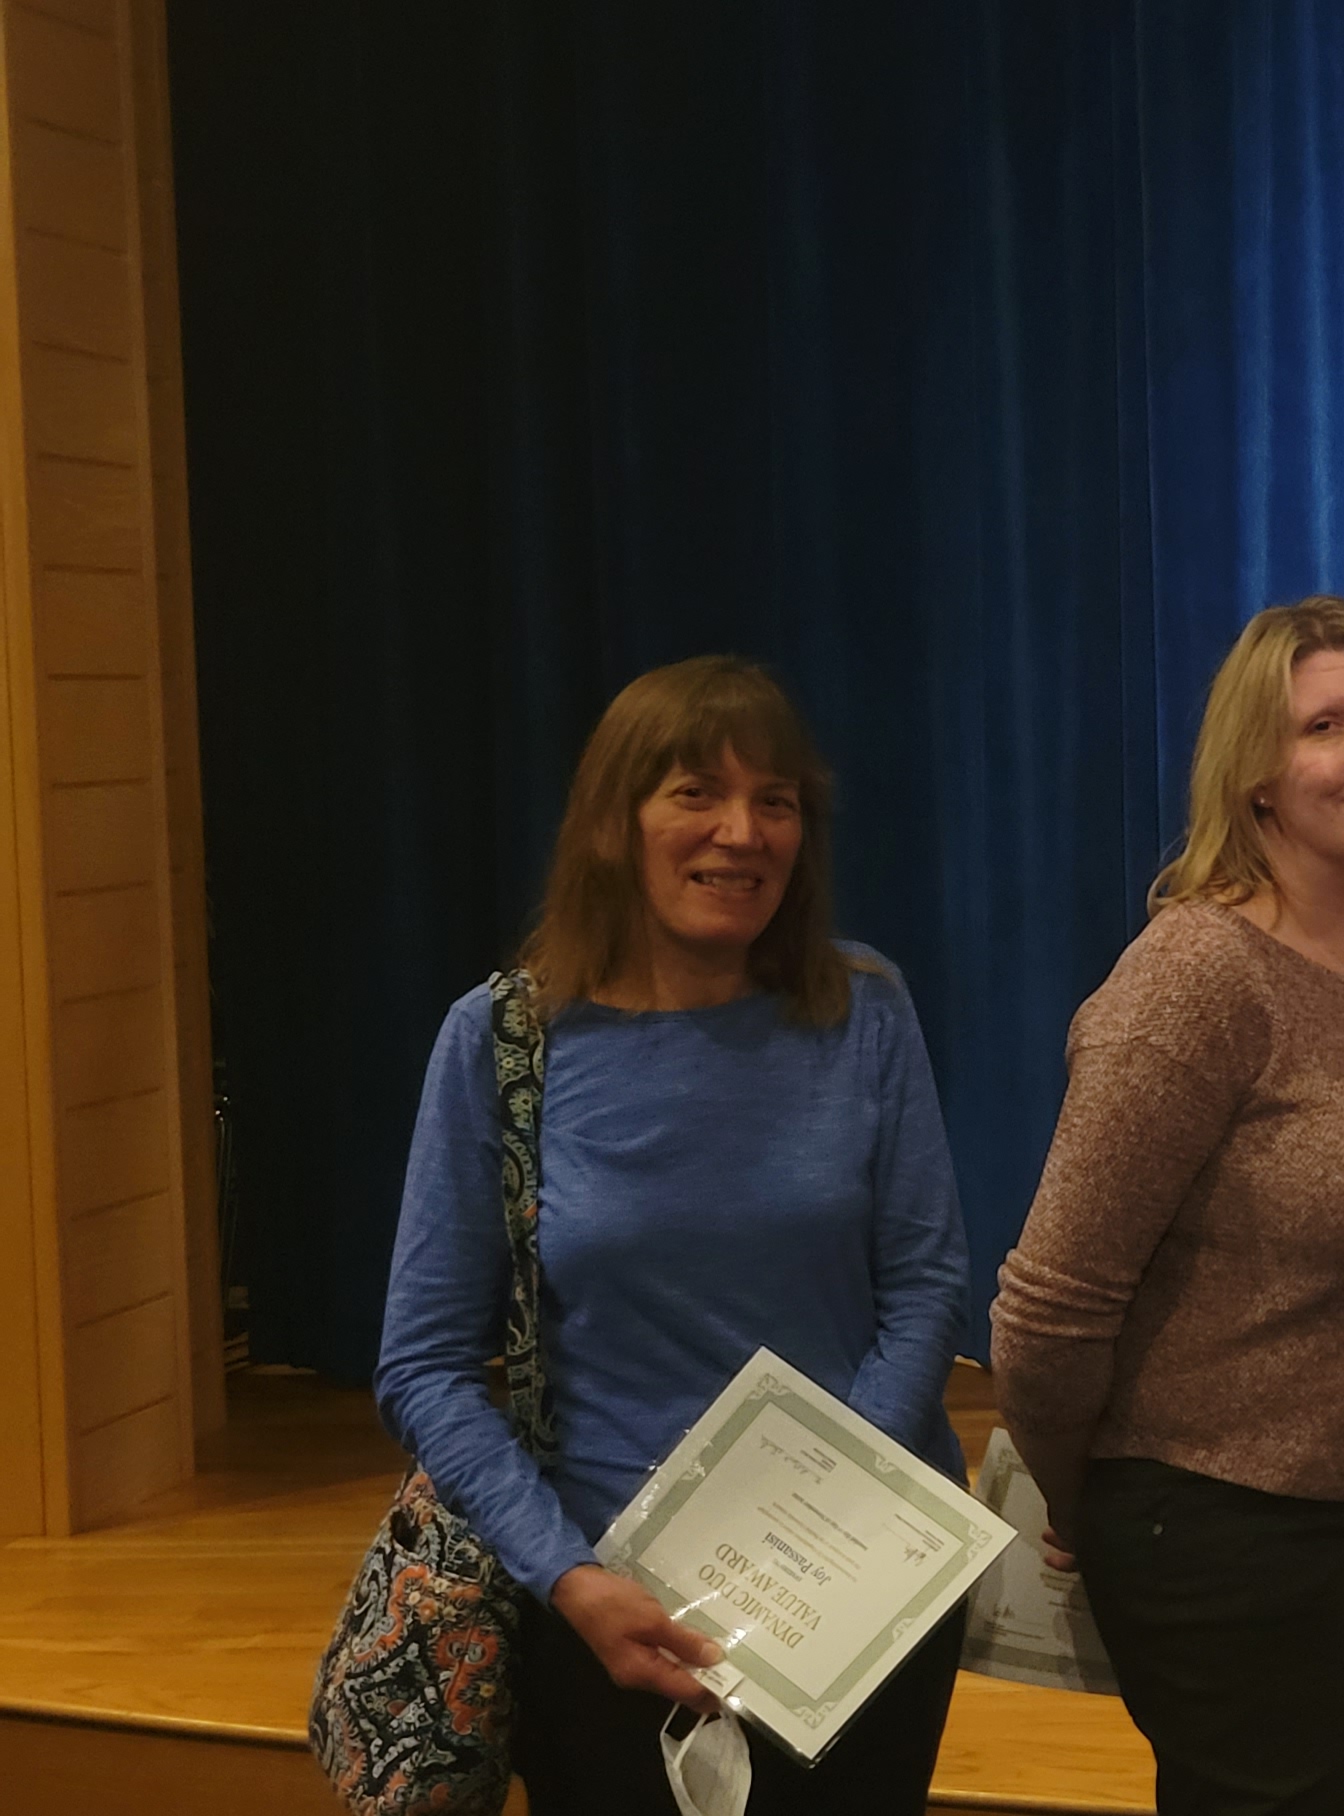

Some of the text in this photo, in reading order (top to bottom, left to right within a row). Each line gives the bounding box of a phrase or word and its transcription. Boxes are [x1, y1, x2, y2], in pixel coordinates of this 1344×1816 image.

[715, 1543, 779, 1593] AWARD
[761, 1531, 814, 1574] Passanisi
[698, 1564, 739, 1599] DUO
[810, 1566, 832, 1586] Joy
[732, 1591, 805, 1649] DYNAMIC
[771, 1586, 822, 1631] VALUE
